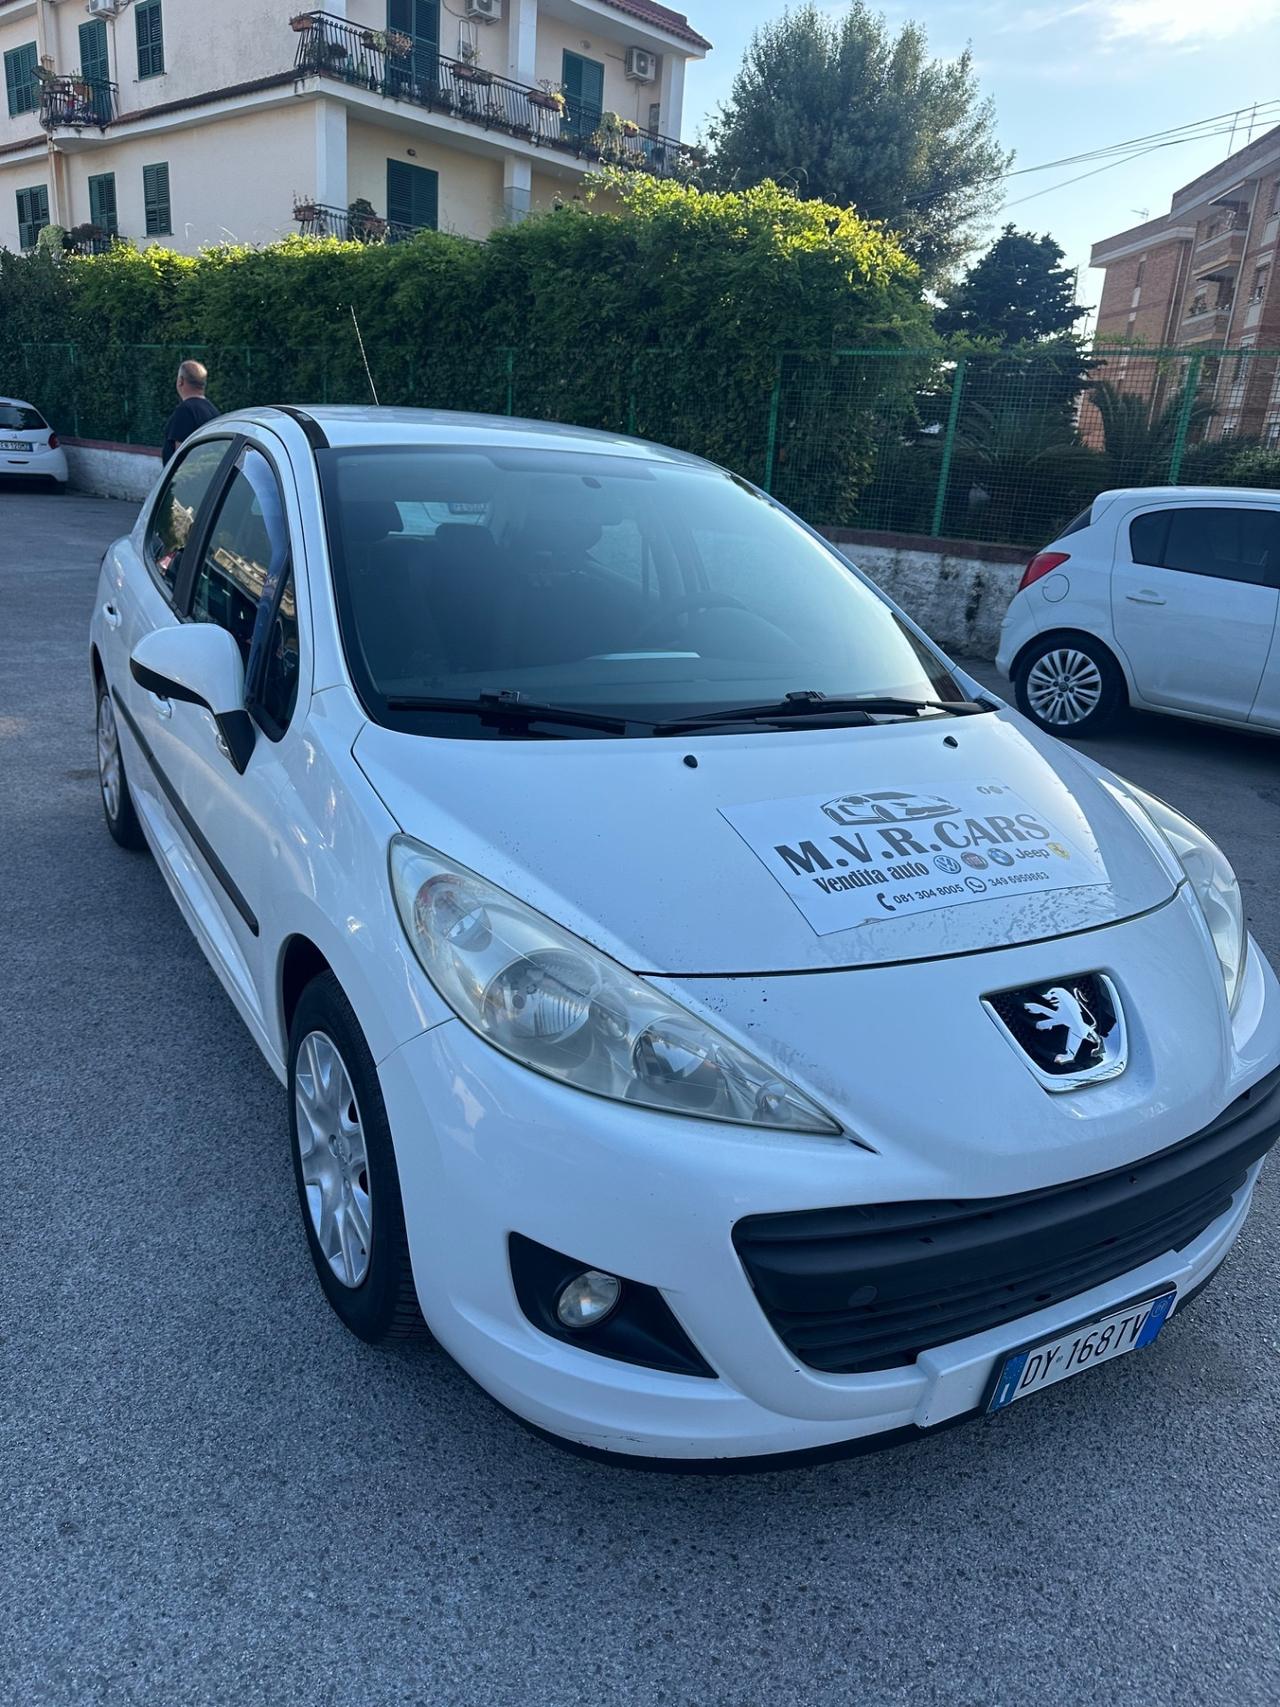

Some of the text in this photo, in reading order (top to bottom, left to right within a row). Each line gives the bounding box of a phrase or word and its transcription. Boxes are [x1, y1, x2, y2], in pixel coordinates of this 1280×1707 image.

[1015, 847, 1050, 860] Jeep
[812, 860, 930, 895] Vendita auto
[987, 877, 1009, 887] 349
[893, 883, 965, 905] 081 304 8005
[1020, 1310, 1151, 1389] DY 168TV
